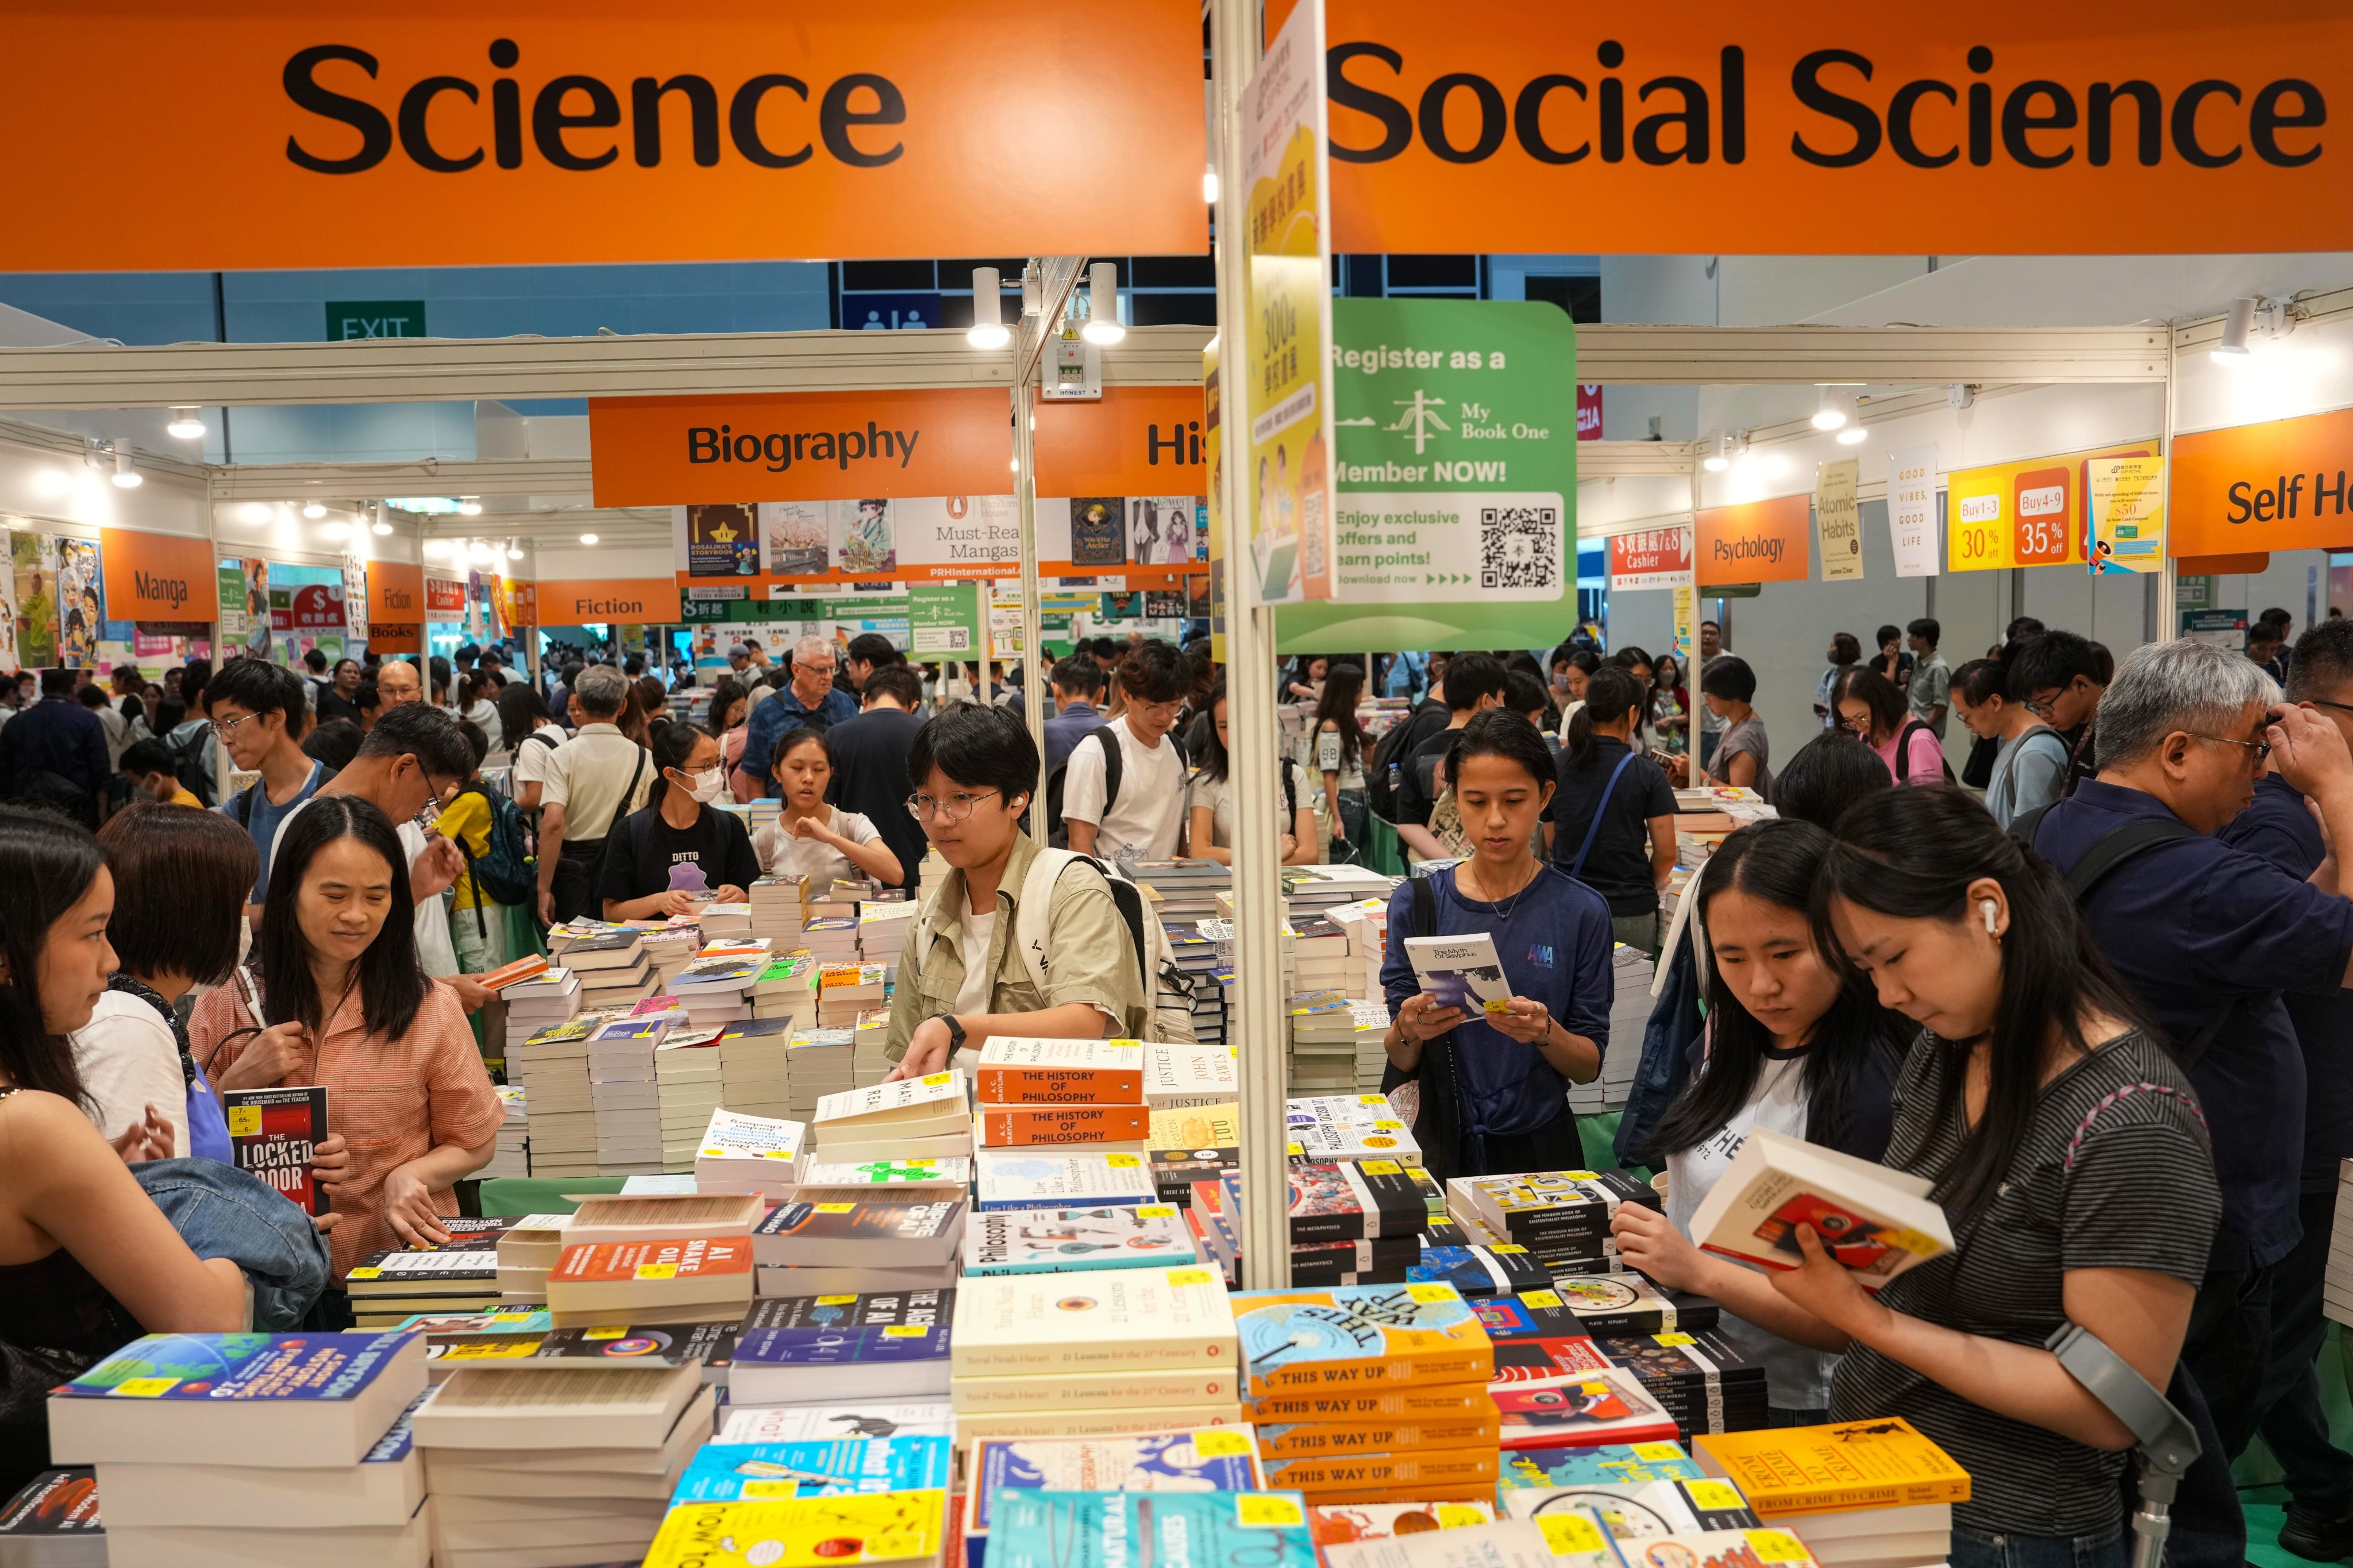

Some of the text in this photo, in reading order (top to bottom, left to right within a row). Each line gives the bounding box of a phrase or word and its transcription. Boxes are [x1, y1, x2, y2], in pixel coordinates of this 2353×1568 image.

[282, 38, 907, 175] Science
[1326, 40, 1745, 166] Social
[1790, 45, 2328, 169] Science
[342, 318, 409, 340] EXIT
[1331, 345, 1505, 375] Register as a
[1462, 403, 1490, 423] My
[1462, 423, 1550, 440] Book One
[688, 422, 919, 472] Biography
[1148, 422, 1206, 466] Hi
[1334, 461, 1507, 482] Member NOW!
[1899, 468, 1925, 480] GOOD
[980, 499, 1018, 508] Random
[1818, 493, 1855, 515] Atomic
[1900, 491, 1927, 502] VIBES,
[2227, 473, 2305, 525] Self
[980, 510, 1010, 518] House
[2115, 503, 2137, 516] $50
[1336, 510, 1459, 527] Enjoy exclusive
[1899, 514, 1924, 525] GOOD
[935, 525, 1020, 541] Must-Rea
[1337, 531, 1416, 545] offers and
[1822, 519, 1855, 540] Habits
[2021, 522, 2063, 554] 35 %
[1903, 536, 1921, 546] LIFE
[1962, 529, 1998, 559] 30 %
[2051, 542, 2063, 554] off
[949, 544, 1018, 561] Mangas
[1714, 535, 1785, 566] Psychology
[1337, 552, 1431, 569] earn points!
[1627, 554, 1659, 569] Cashier
[135, 570, 188, 610] Manga
[384, 588, 411, 610] Fiction
[575, 598, 643, 615] Fiction
[371, 626, 414, 638] Books
[1322, 748, 1338, 761] 98
[672, 851, 699, 862] DITTO
[1203, 927, 1217, 938] JARED
[1209, 919, 1227, 938] DIAMOND
[1156, 1048, 1179, 1087] JUSTICE
[1191, 1056, 1213, 1080] JOHN
[1212, 1054, 1233, 1082] RAWLS
[1022, 1072, 1095, 1081] THE HISTORY
[1050, 1082, 1067, 1091] OF
[1022, 1092, 1096, 1101] PHILOSOPHY
[1168, 1097, 1222, 1109] JUSTICE
[730, 1119, 782, 1129] Ellenberg
[730, 1127, 776, 1135] Thinking
[1211, 1120, 1234, 1141] 100
[1336, 1122, 1352, 1131] 101
[268, 1133, 286, 1142] THE
[713, 1130, 791, 1140] Mathematical
[242, 1139, 314, 1169] LOCKED
[862, 1165, 936, 1178] UNEQUAL
[1070, 1158, 1085, 1193] Philosopher
[898, 1205, 929, 1232] OF AI
[915, 1201, 954, 1238] EMPIRE
[978, 1213, 1012, 1263] Philosophy
[679, 1239, 708, 1273] SNAKE
[707, 1246, 734, 1260] AI
[1280, 1366, 1385, 1385] THIS WAY UP
[1272, 1399, 1378, 1413] THIS WAY UP
[1758, 1489, 1898, 1509] FROM CRIME TO CRIME
